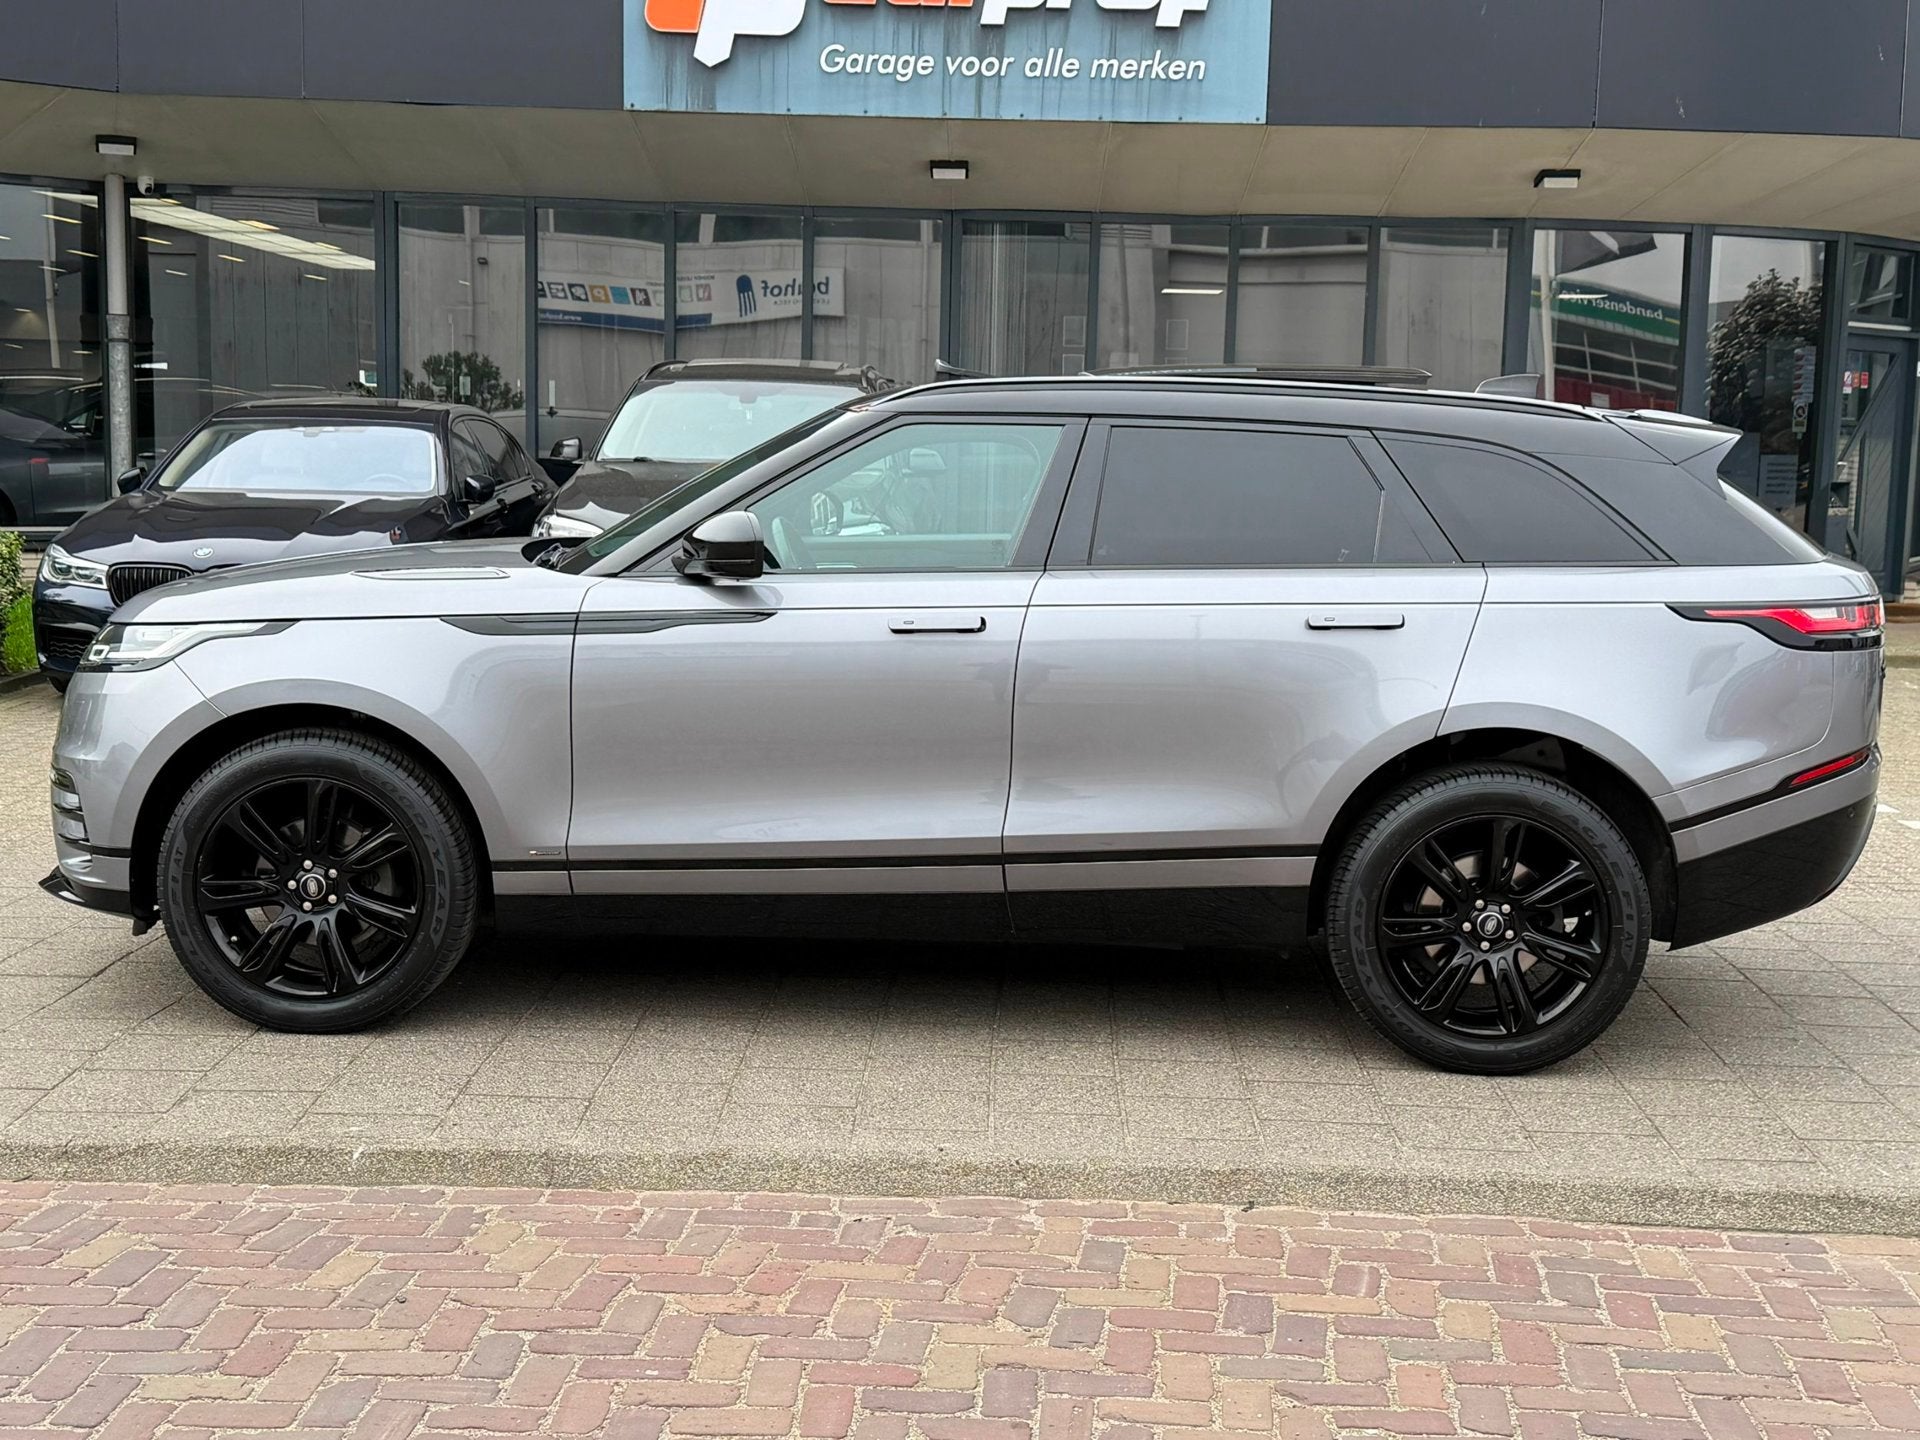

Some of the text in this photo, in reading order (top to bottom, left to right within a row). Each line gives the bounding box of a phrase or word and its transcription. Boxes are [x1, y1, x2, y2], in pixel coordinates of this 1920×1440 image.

[820, 44, 1206, 82] Garage voor alle merken
